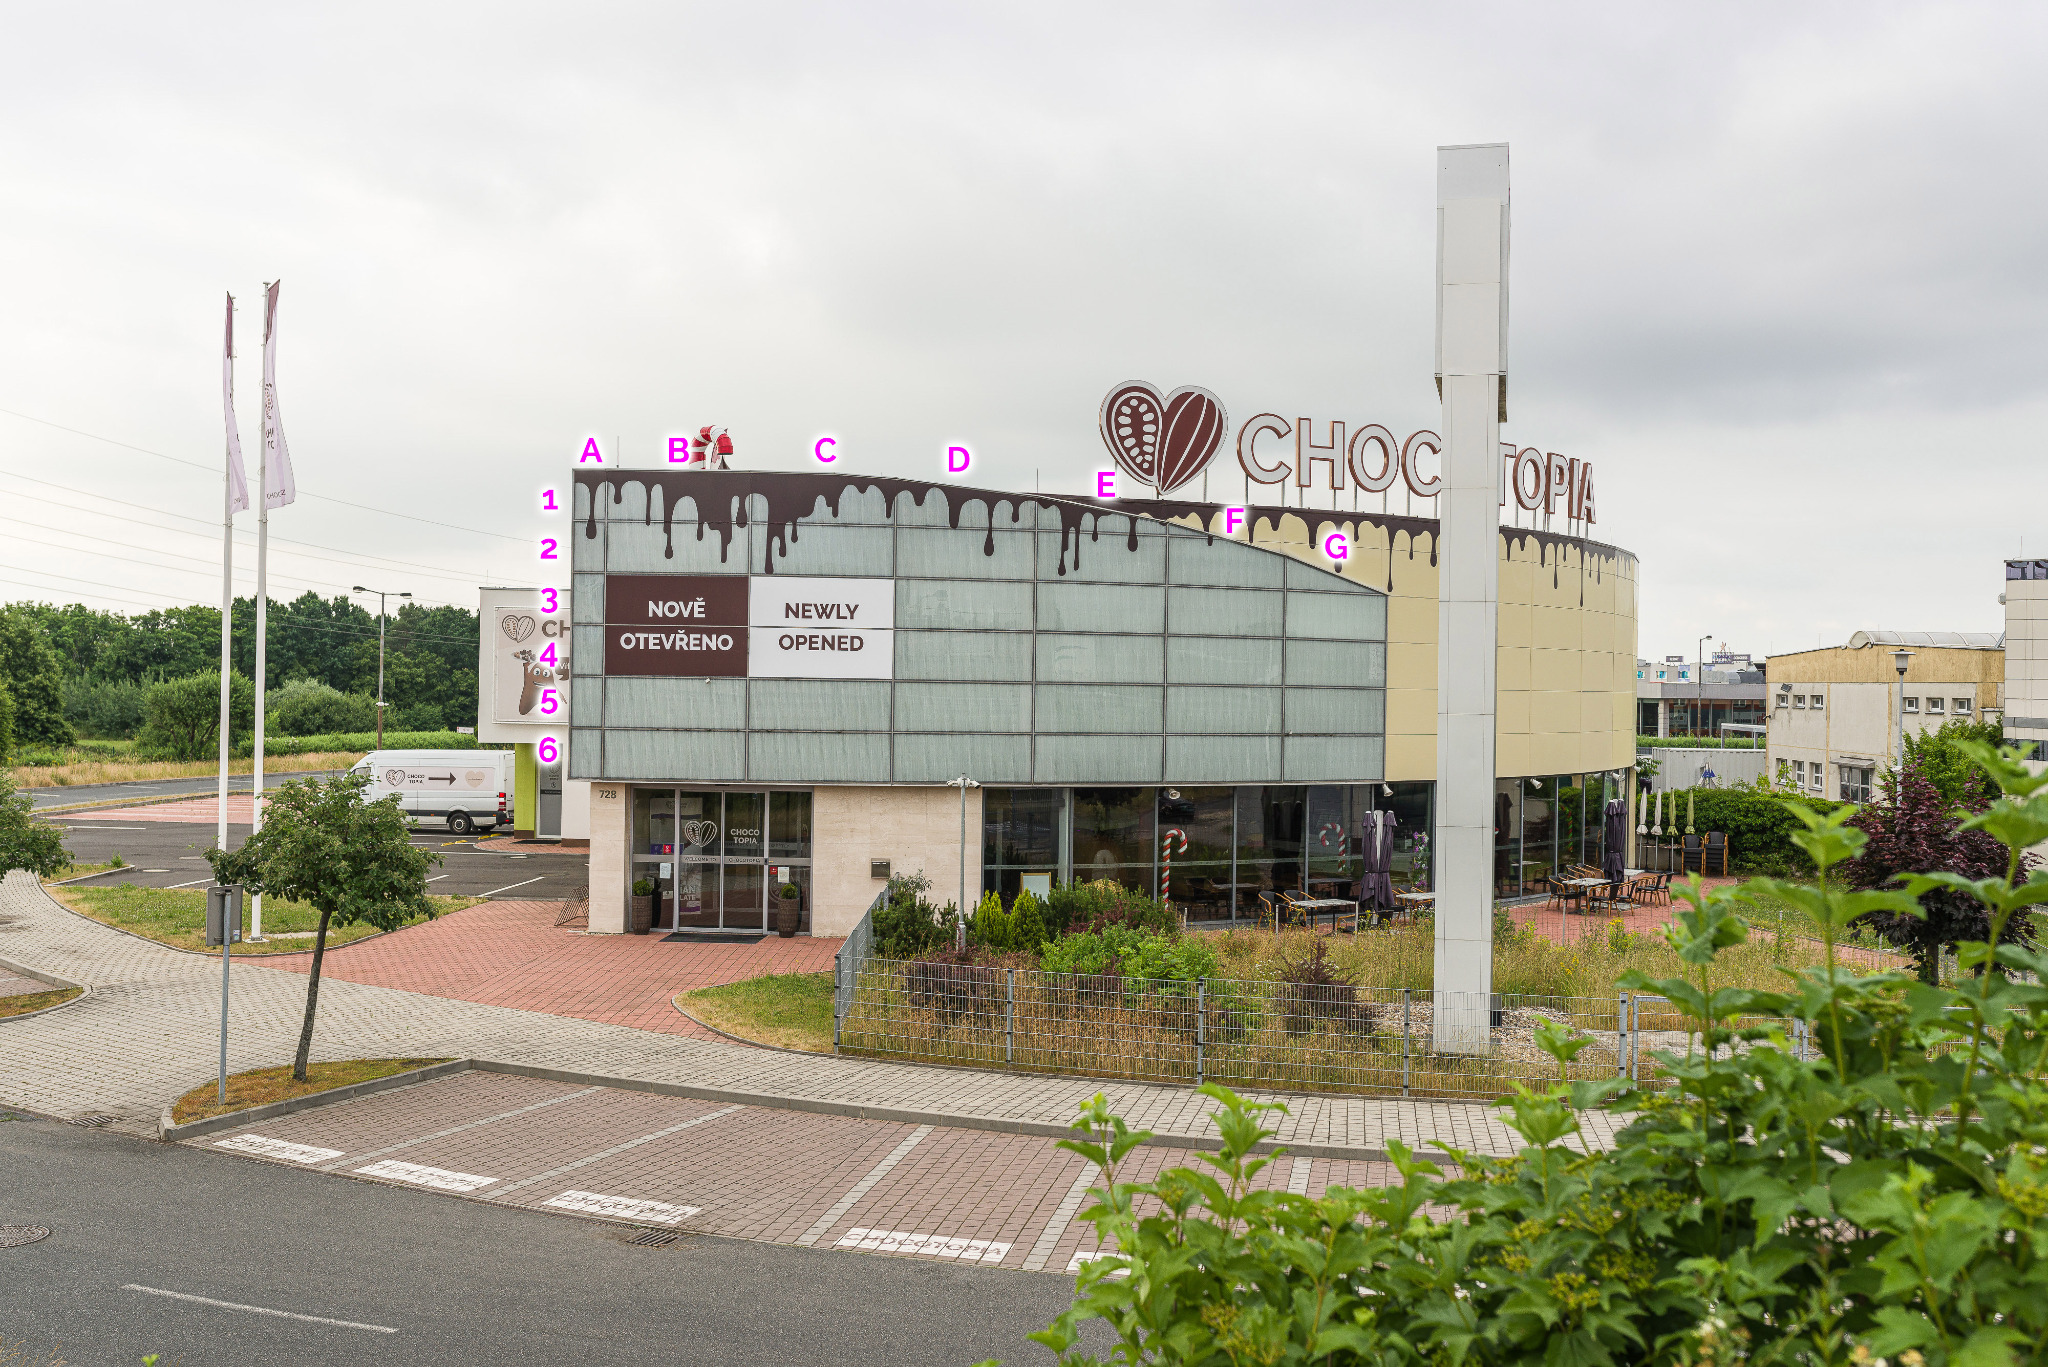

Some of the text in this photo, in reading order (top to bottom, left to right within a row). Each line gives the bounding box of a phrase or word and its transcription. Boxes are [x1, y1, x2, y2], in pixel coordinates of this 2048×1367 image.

[1237, 413, 1596, 524] CHOCTOPIA
[648, 597, 706, 618] NOVĚ
[785, 603, 859, 619] NEWLY
[620, 629, 734, 651] OTEVŘENO
[778, 634, 864, 651] OPENED
[599, 789, 617, 799] 728
[730, 828, 760, 836] CHOCO
[733, 836, 758, 844] TOPIA
[844, 1232, 1002, 1256] CHOCOTOPIA
